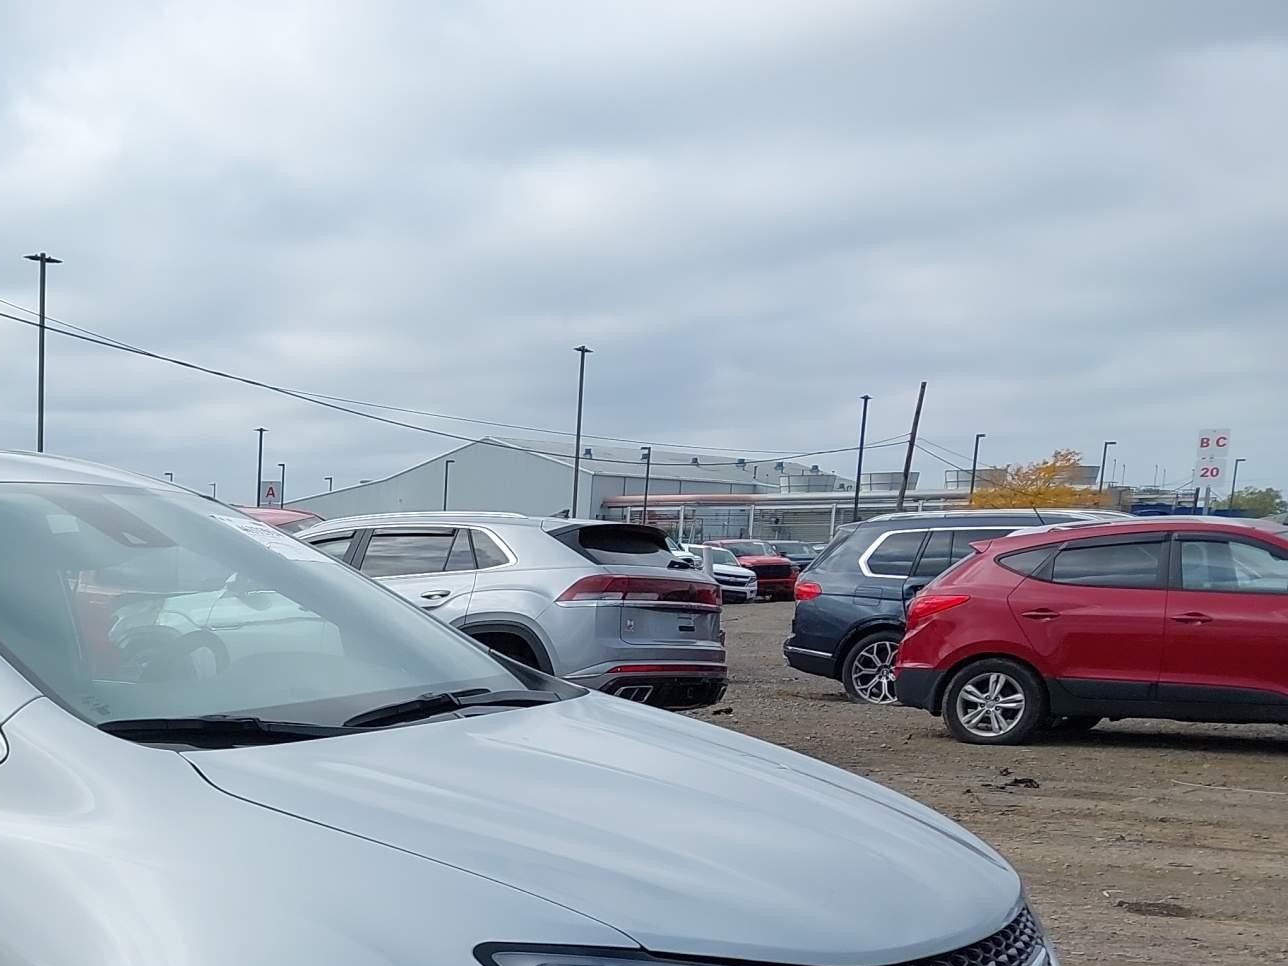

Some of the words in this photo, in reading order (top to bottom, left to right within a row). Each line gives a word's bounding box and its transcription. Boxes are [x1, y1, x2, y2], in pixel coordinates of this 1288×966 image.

[1199, 437, 1211, 448] B
[1215, 436, 1228, 448] C
[1199, 467, 1220, 478] 20
[265, 486, 276, 498] A
